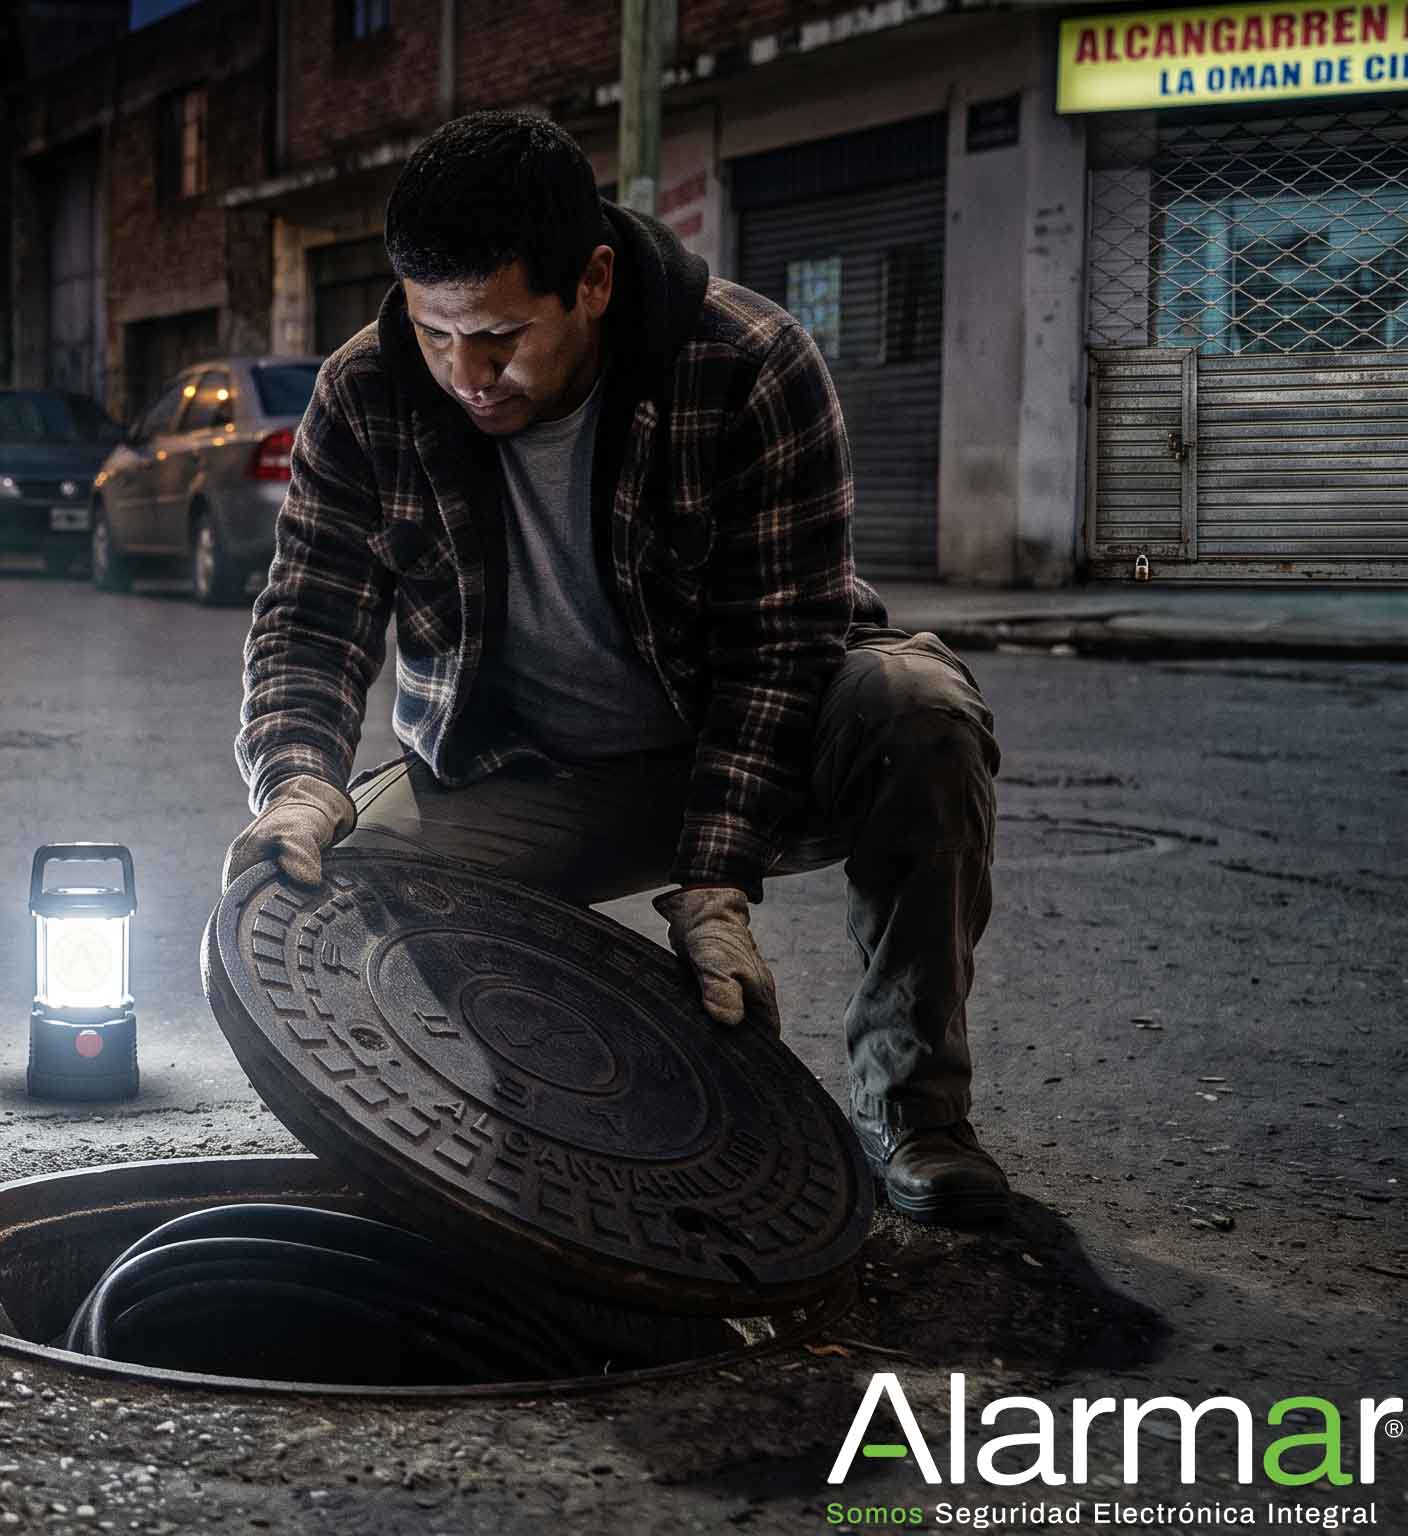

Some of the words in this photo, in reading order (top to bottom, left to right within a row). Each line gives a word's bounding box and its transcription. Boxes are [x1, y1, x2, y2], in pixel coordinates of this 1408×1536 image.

[1075, 5, 1388, 63] ALCANGARREN
[1160, 69, 1197, 96] LA
[1207, 62, 1301, 91] OMAN
[1314, 56, 1353, 85] DE
[1365, 52, 1408, 81] CI
